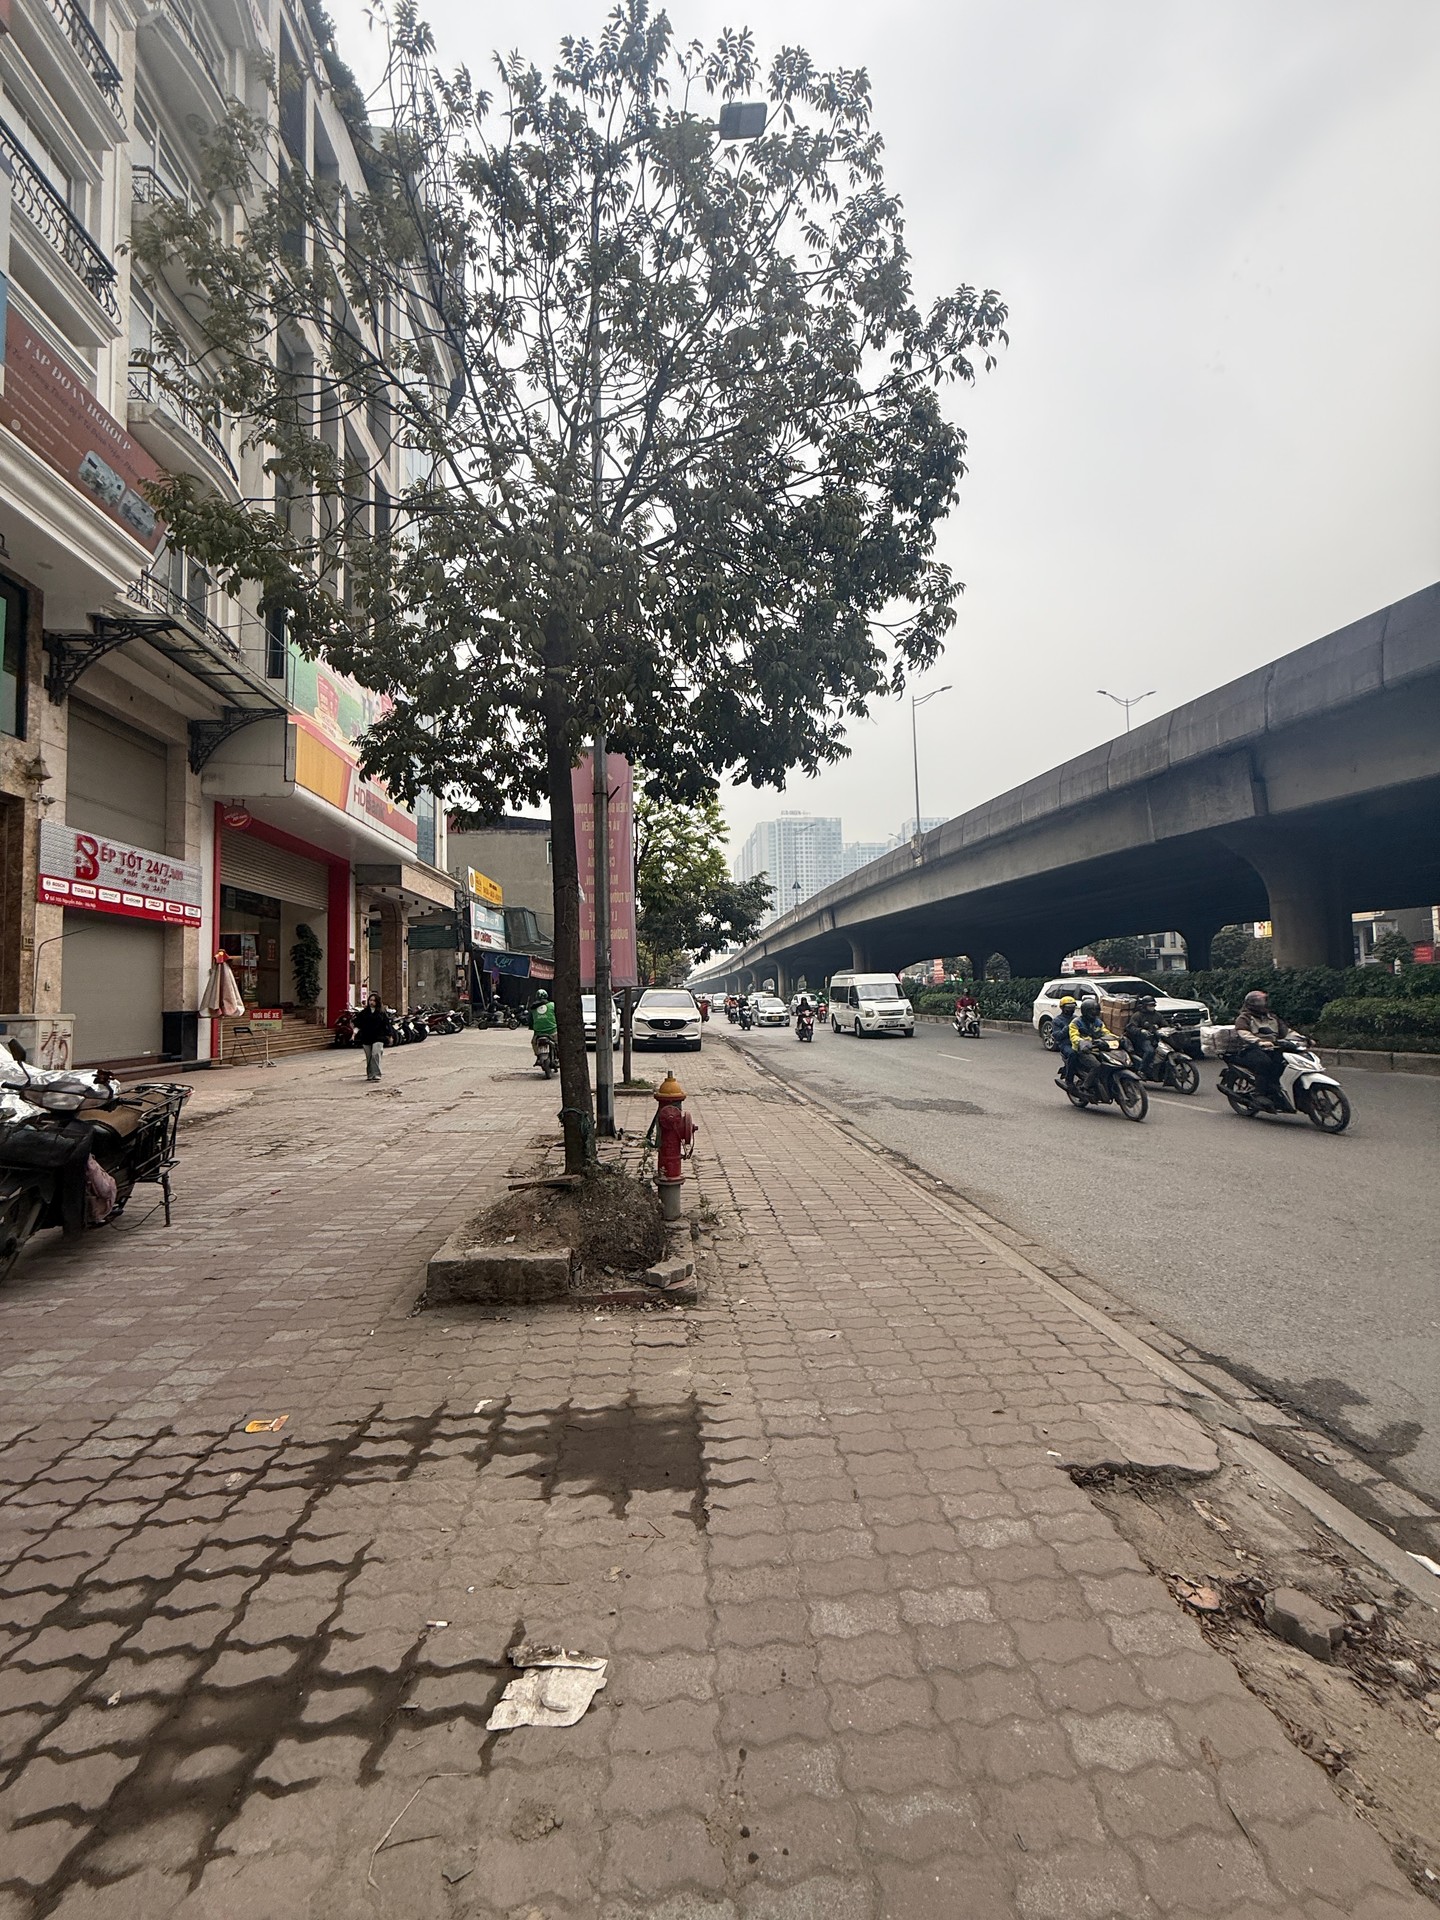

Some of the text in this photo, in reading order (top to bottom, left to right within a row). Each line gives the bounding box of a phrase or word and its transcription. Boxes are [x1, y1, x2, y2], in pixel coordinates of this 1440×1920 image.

[86, 403, 131, 450] HGROUP
[119, 850, 143, 870] TỐT
[74, 886, 95, 896] TOSHIBA
[252, 1011, 262, 1019] NƠI
